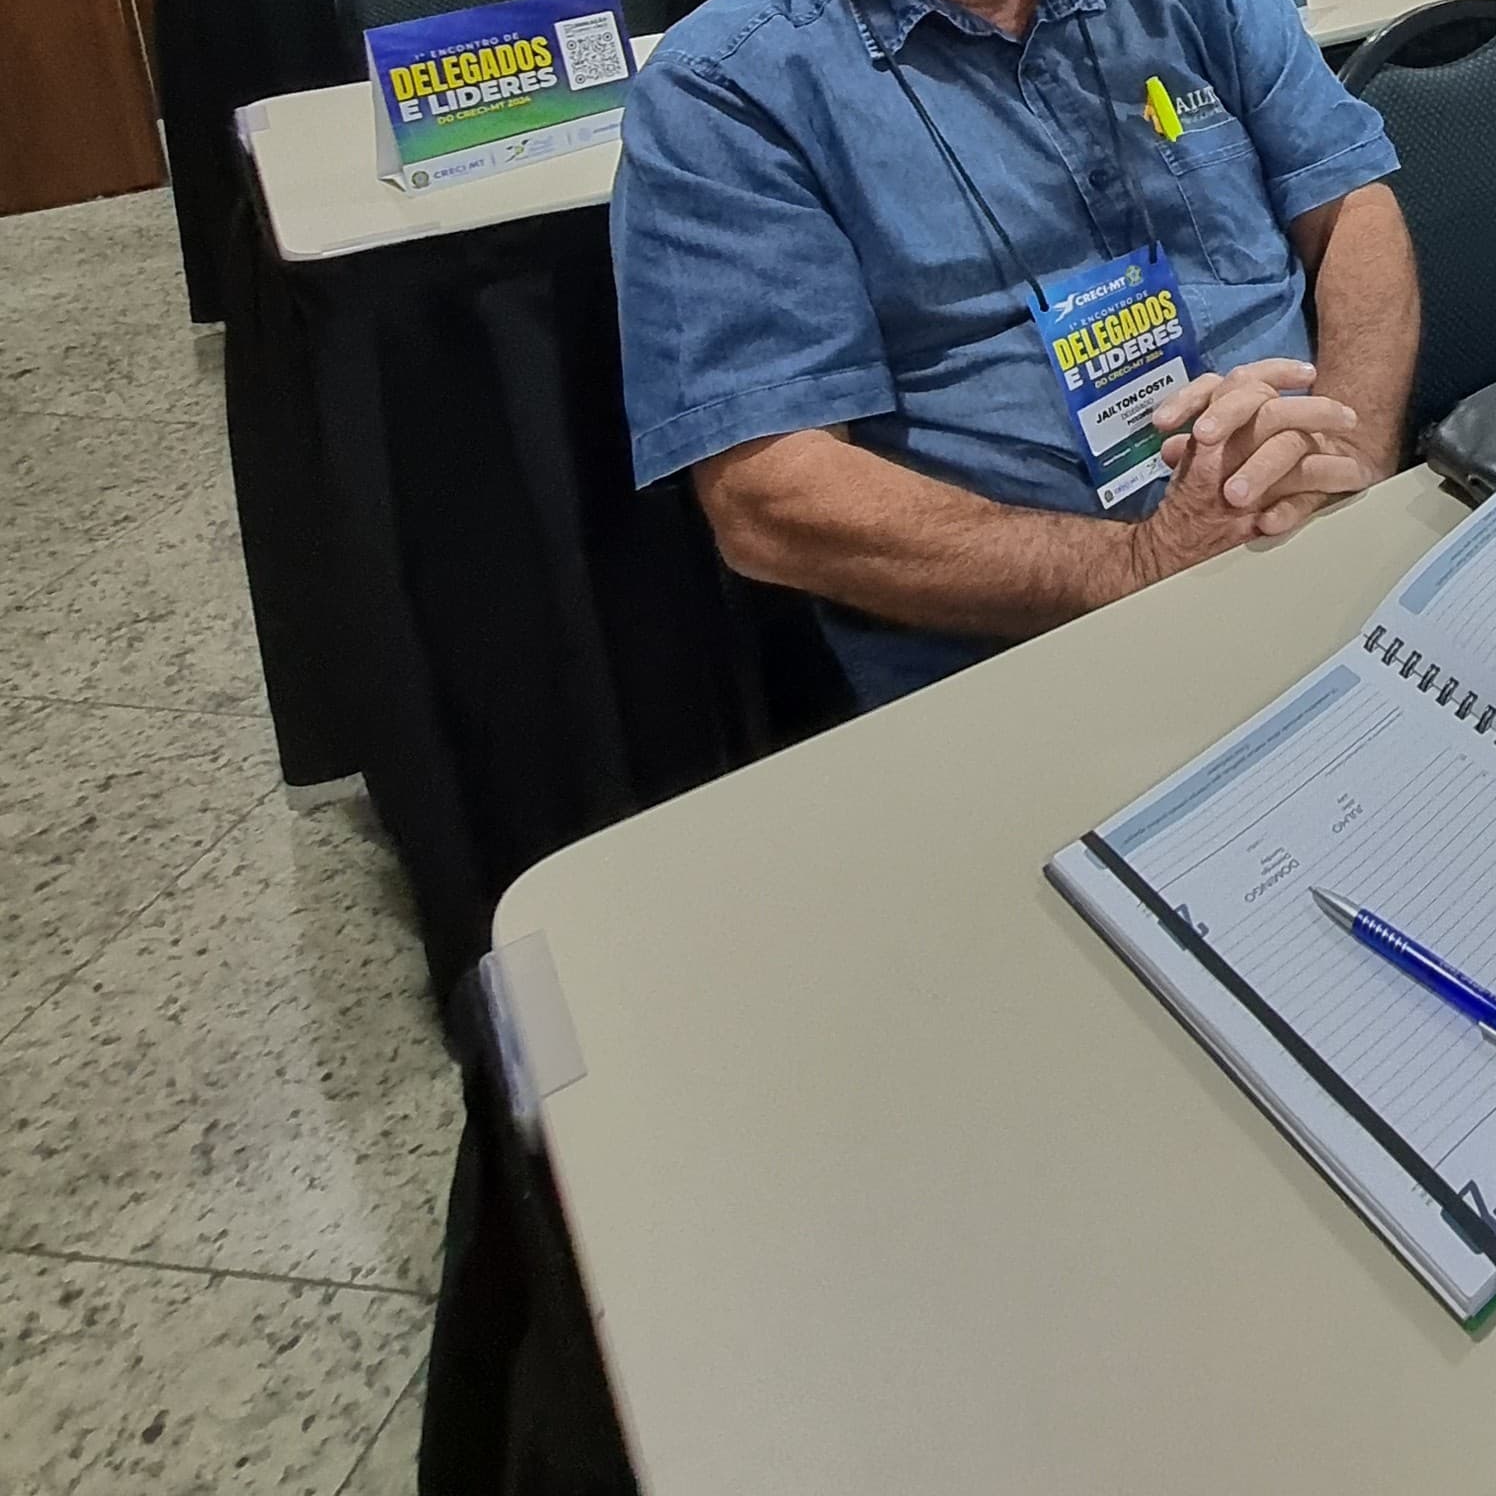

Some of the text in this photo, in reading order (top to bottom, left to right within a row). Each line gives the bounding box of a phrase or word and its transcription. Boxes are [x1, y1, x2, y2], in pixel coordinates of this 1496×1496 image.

[390, 36, 552, 101] DELEGADOS
[400, 66, 558, 122] E LIDERES
[1076, 277, 1126, 306] CRECI-MT
[1081, 298, 1132, 325] ENCONTRO
[1136, 290, 1148, 301] DE
[1053, 290, 1176, 371] DELEGADOS
[1064, 319, 1182, 391] E LIDERES
[1097, 393, 1138, 424] JAILTON
[1138, 375, 1174, 399] COSTA
